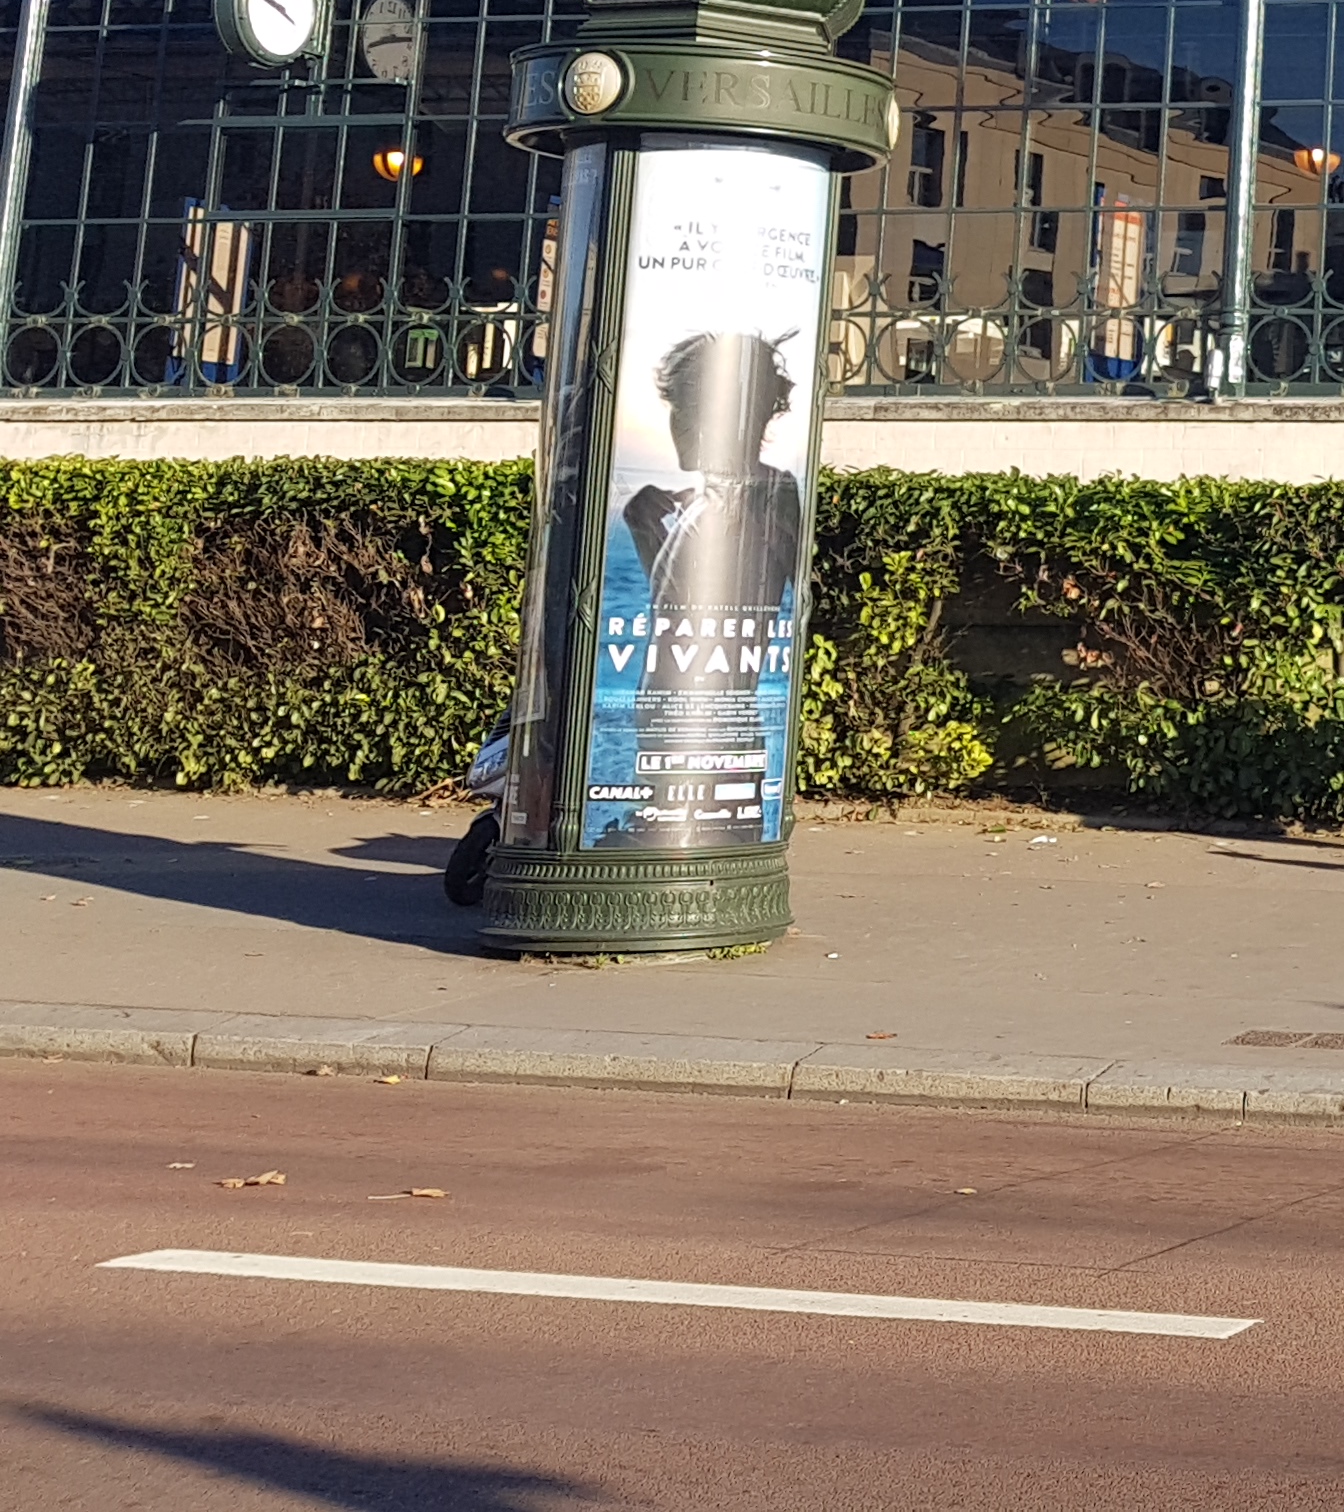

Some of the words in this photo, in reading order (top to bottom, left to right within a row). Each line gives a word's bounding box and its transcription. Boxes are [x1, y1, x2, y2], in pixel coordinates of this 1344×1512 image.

[644, 68, 886, 131] VERSAILLES
[638, 254, 666, 270] UN
[670, 256, 708, 271] PUR
[608, 613, 756, 638] RÉPARER
[768, 619, 793, 638] LES
[608, 644, 792, 674] VIVANTS
[641, 756, 661, 770] LE
[589, 786, 654, 800] CANAL+
